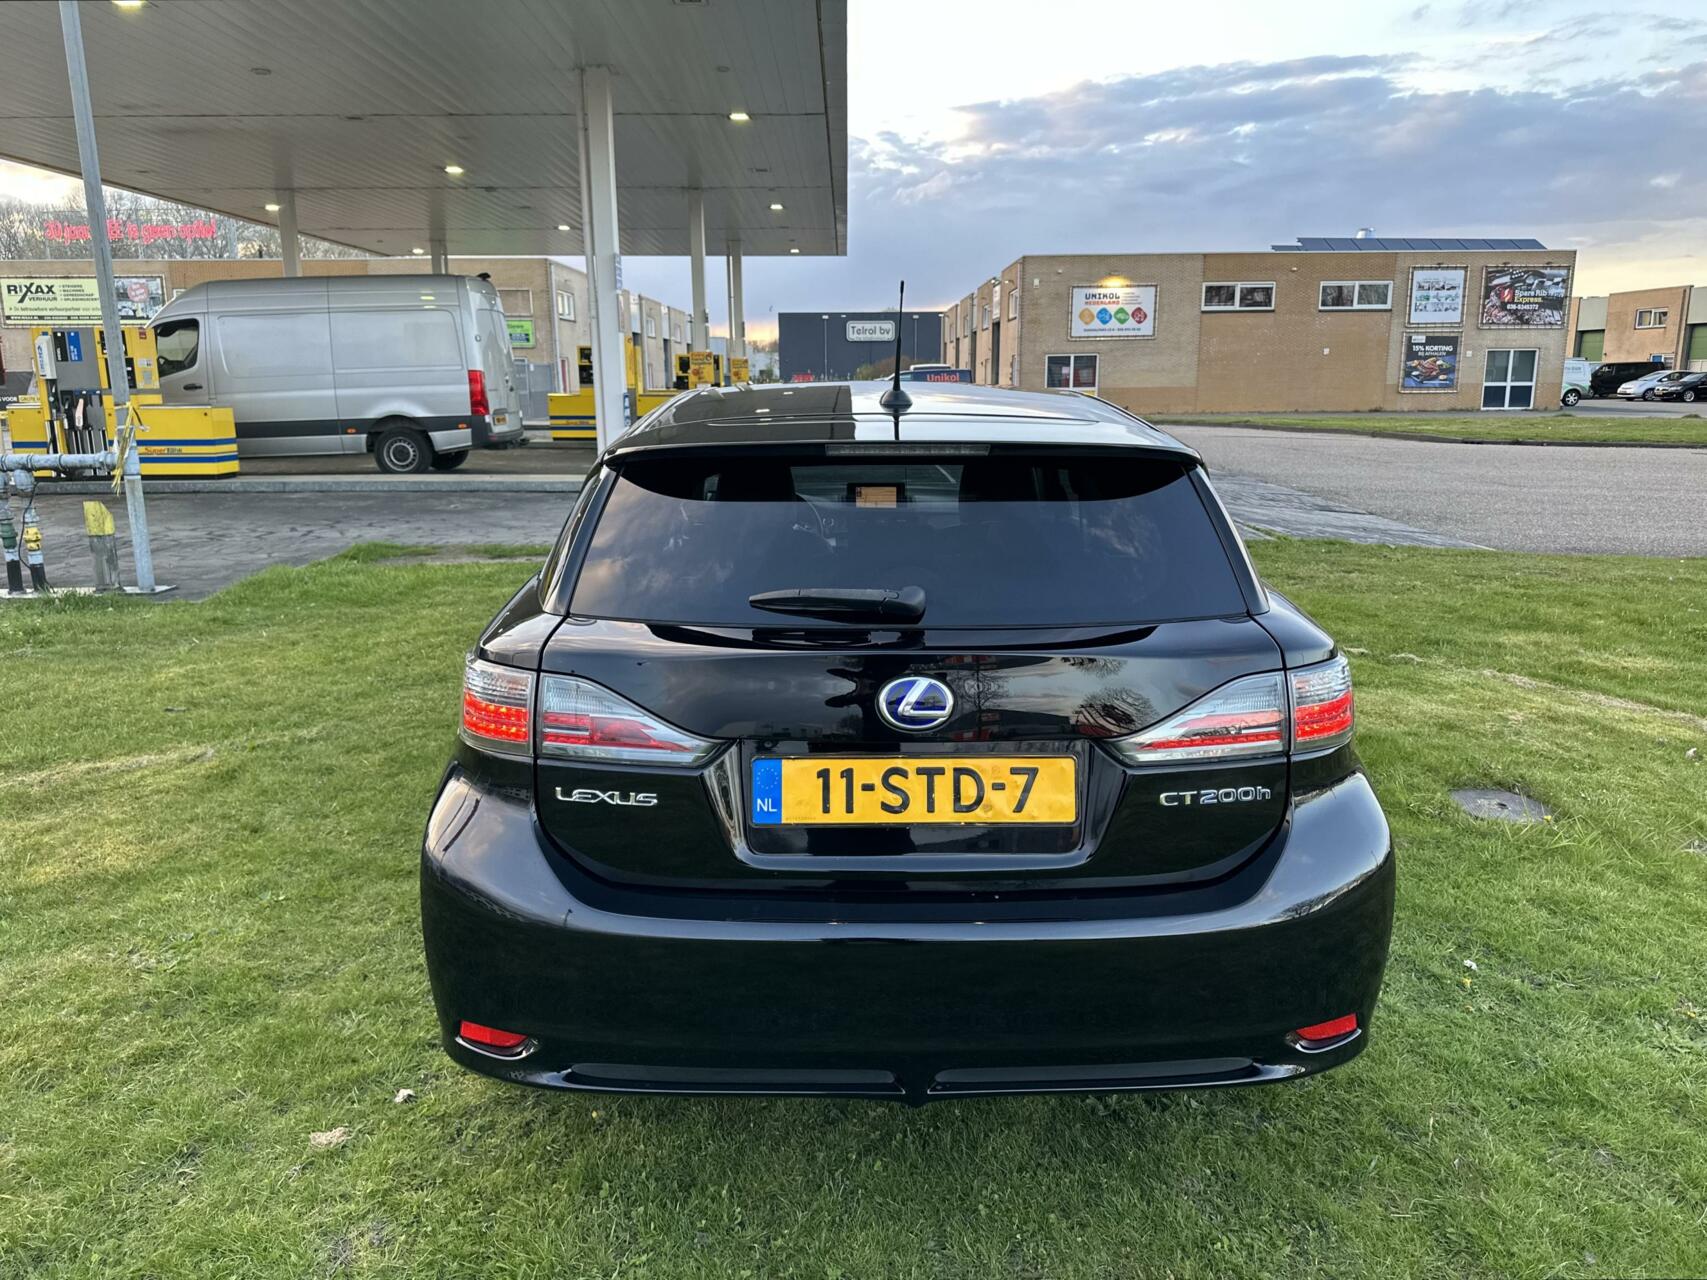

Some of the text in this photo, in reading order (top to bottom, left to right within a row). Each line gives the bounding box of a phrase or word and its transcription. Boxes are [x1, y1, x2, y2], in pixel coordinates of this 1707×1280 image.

[1514, 289, 1535, 297] Spare
[850, 325, 891, 336] Telrol bv
[927, 372, 960, 382] Unikol
[555, 786, 658, 807] LEXUS
[816, 766, 1039, 815] 11-STD-7
[756, 798, 778, 813] NL
